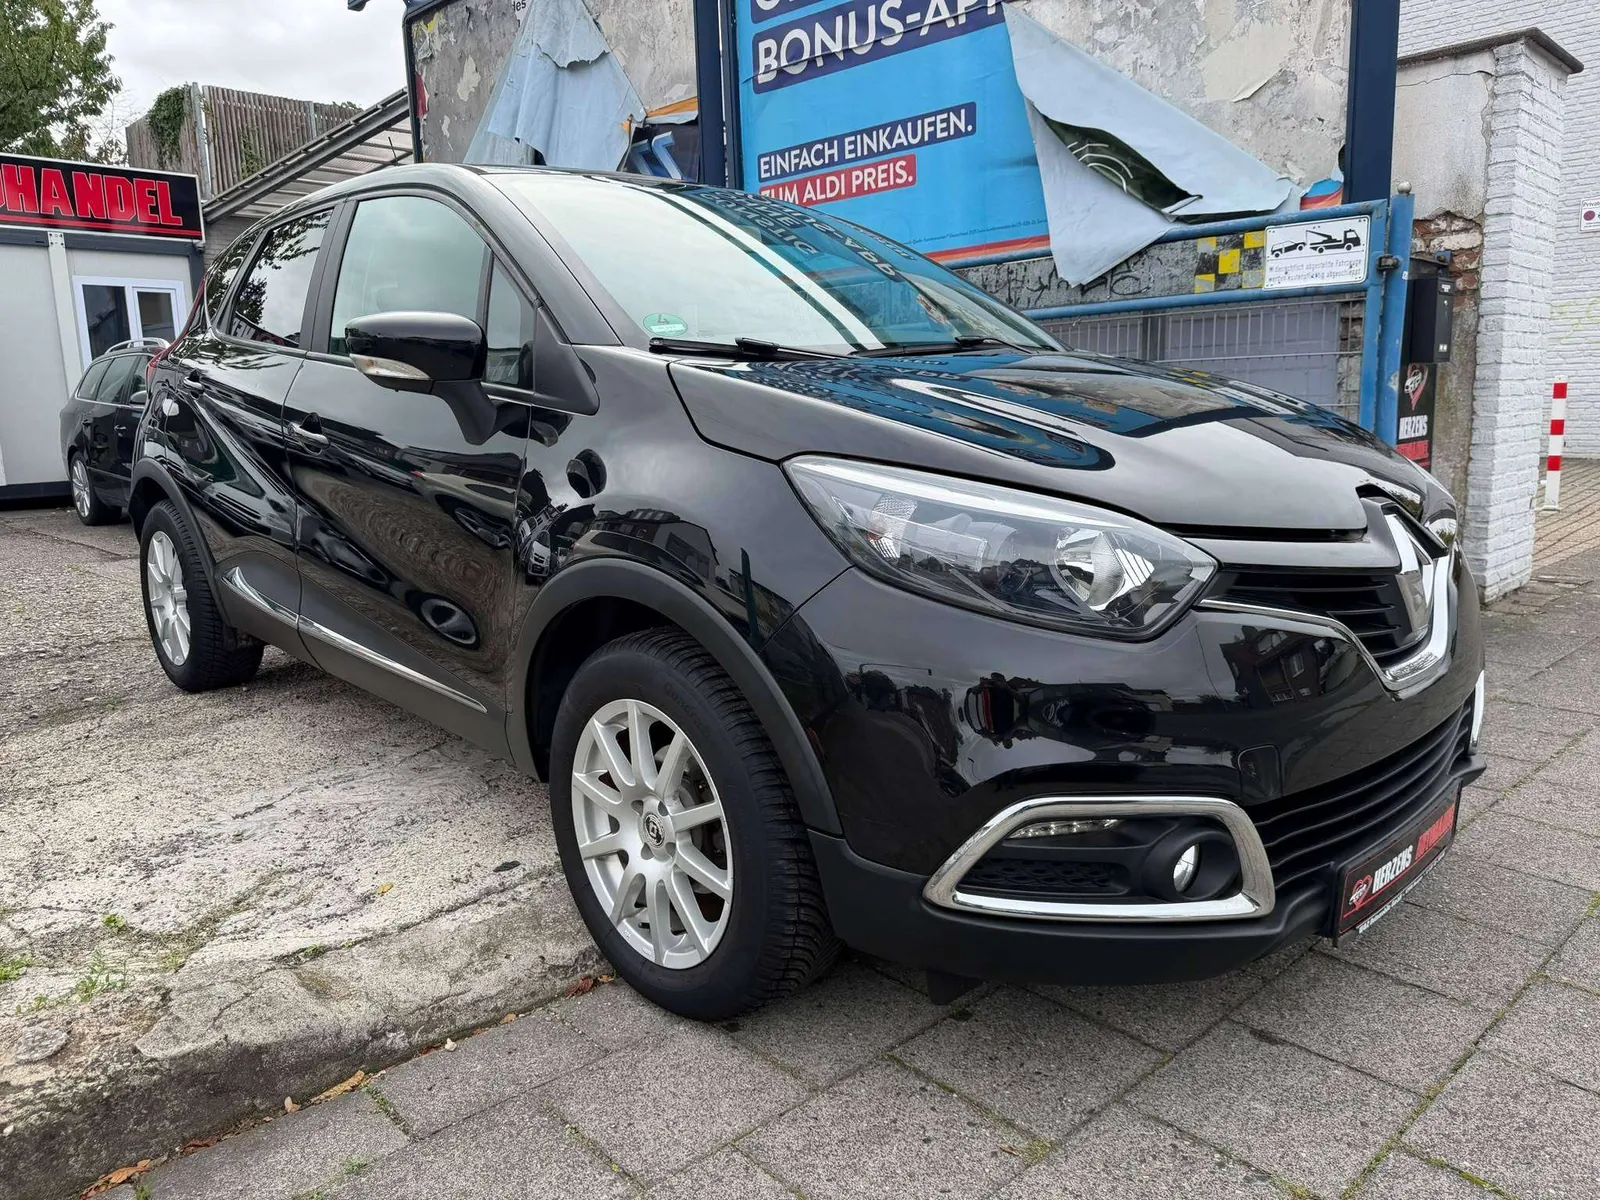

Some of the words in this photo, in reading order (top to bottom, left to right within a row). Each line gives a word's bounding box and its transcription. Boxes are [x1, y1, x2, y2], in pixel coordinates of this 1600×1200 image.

[757, 0, 996, 84] BONUS-AP
[760, 140, 838, 179] EINFACH
[844, 108, 973, 160] EINKAUFEN.
[0, 163, 183, 226] HANDEL
[802, 173, 846, 204] ALDI
[851, 160, 914, 194] PREIS.
[1398, 414, 1429, 441] HERZENS
[1372, 845, 1414, 894] HERZENS
